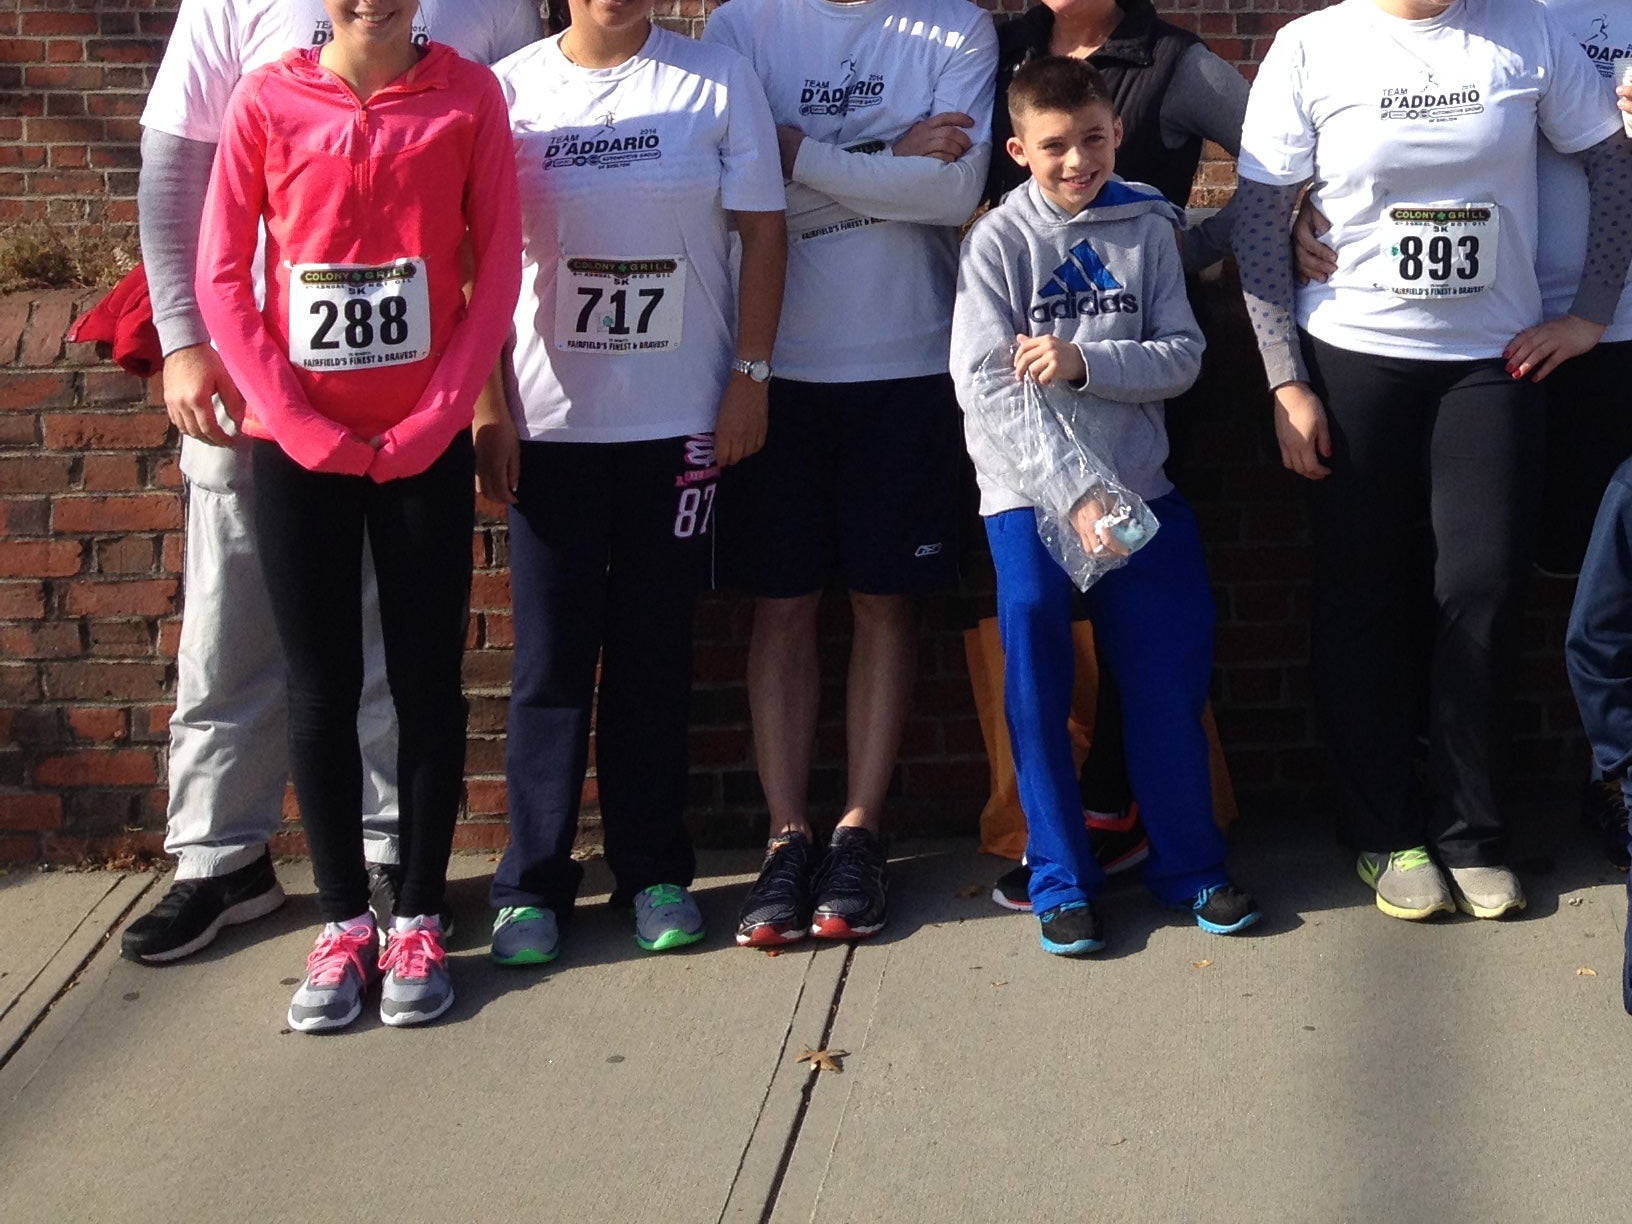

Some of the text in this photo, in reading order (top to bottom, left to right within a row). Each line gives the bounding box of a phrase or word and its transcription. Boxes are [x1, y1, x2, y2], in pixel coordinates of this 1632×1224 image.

[804, 79, 830, 88] TEAM
[1382, 87, 1408, 96] TEAM
[1380, 89, 1480, 109] D'ADDARIO
[551, 134, 579, 144] TEAM
[544, 134, 660, 158] D'ADDARIO
[1395, 211, 1486, 219] COLONY GRILL
[1399, 235, 1479, 280] 893
[574, 262, 671, 271] COLONY GRILL
[305, 272, 349, 281] COLONY
[576, 287, 664, 334] 717
[1030, 289, 1139, 323] adidas
[310, 295, 408, 350] 288
[303, 356, 348, 367] FAIRFIELD'S
[349, 354, 377, 365] FINEST
